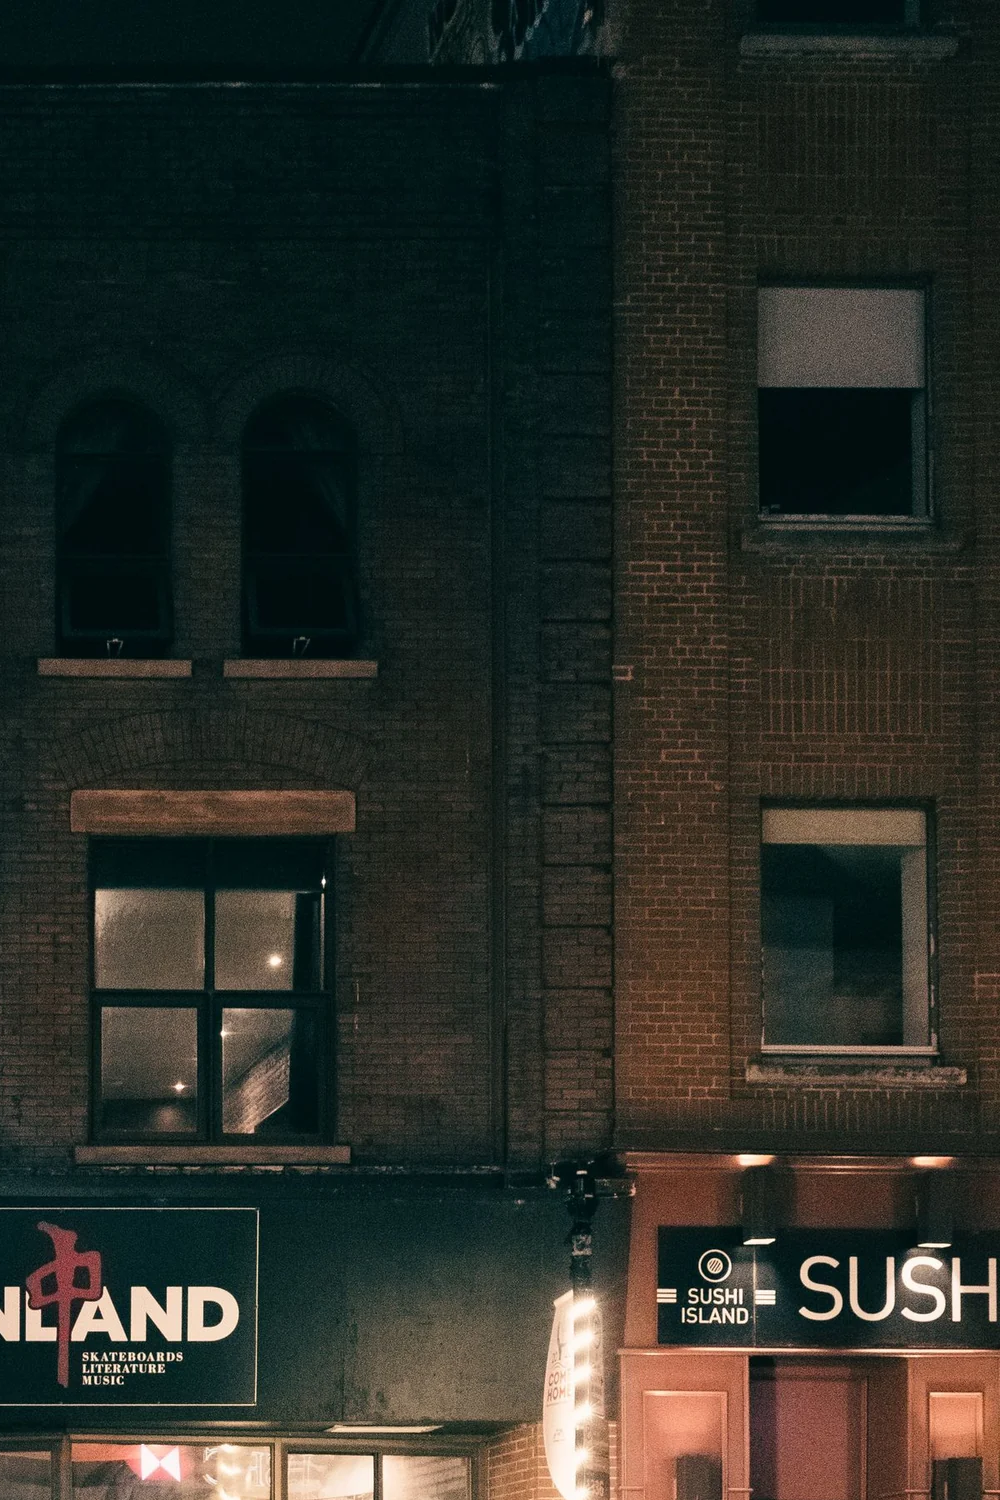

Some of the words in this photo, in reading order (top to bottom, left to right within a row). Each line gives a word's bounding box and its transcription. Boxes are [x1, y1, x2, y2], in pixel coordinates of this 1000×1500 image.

[687, 1288, 744, 1305] SUSHI
[681, 1307, 749, 1324] ISLAND
[82, 1352, 184, 1362] SKATEBOARDS
[82, 1364, 166, 1374] LITERATURE
[82, 1375, 125, 1386] MUSIC
